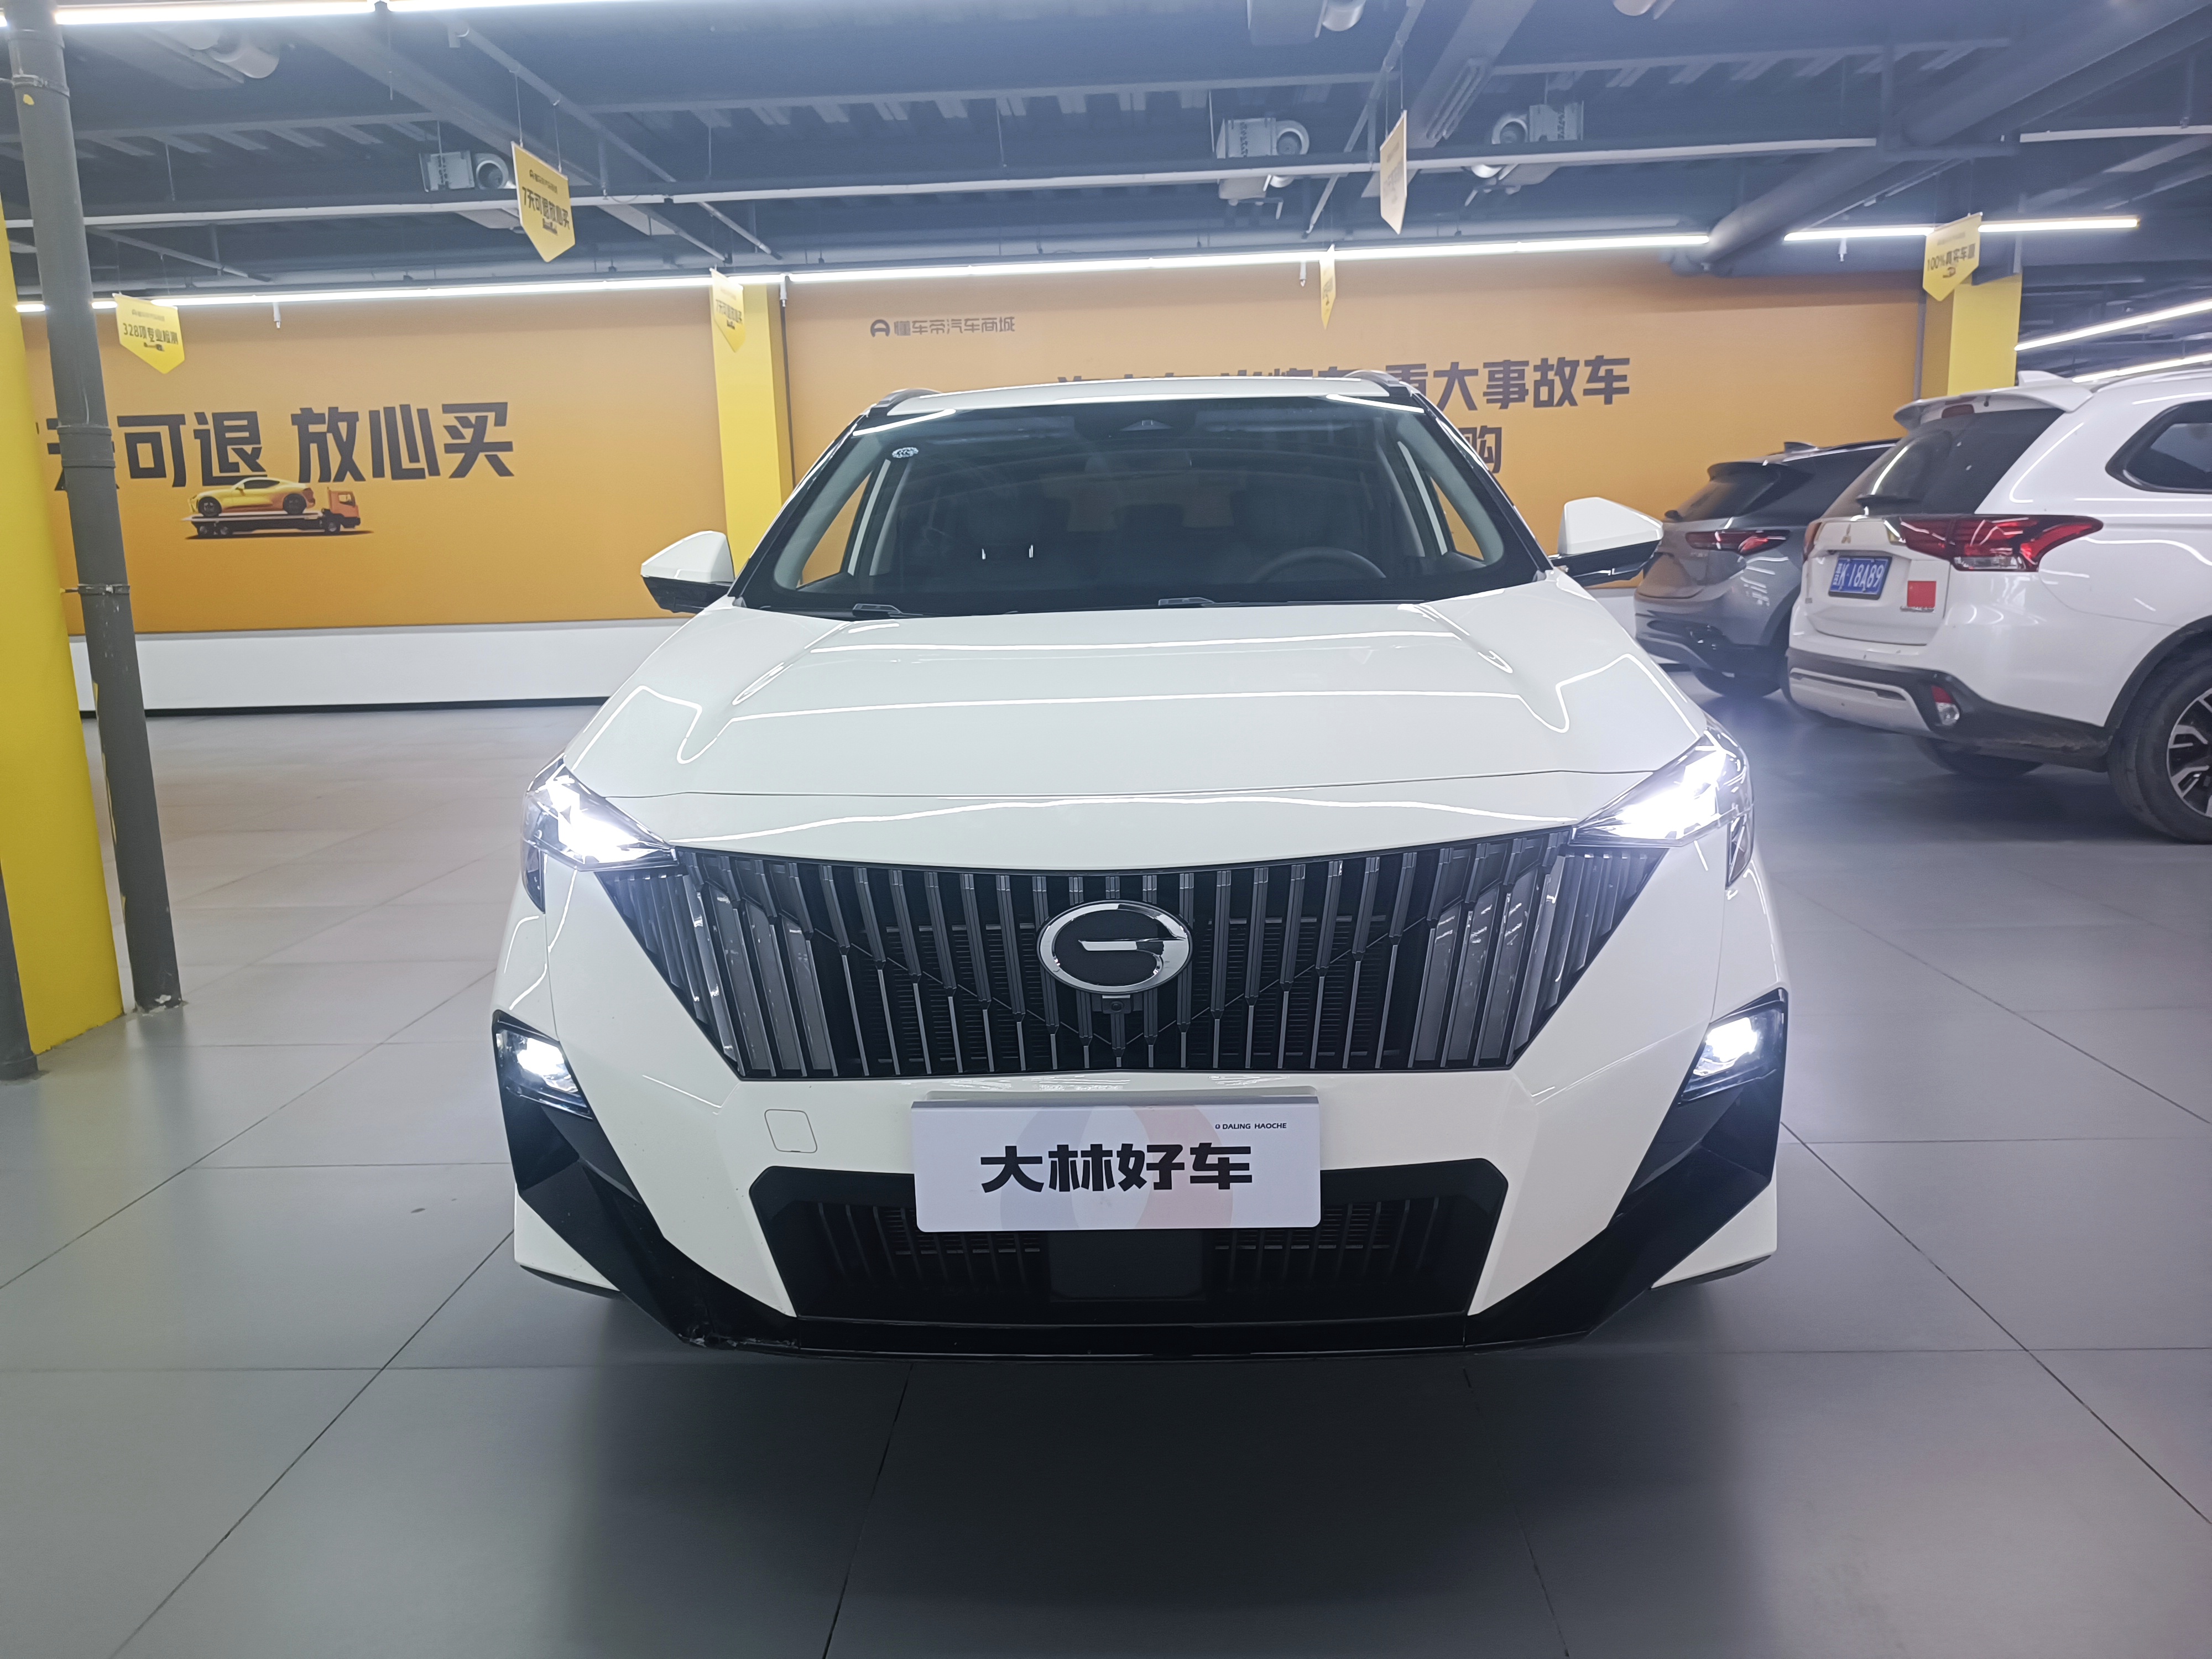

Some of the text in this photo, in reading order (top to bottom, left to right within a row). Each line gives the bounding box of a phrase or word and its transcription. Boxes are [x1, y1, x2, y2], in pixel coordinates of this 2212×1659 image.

[290, 401, 515, 484] 放心买
[980, 1142, 1253, 1193] 大林好车
